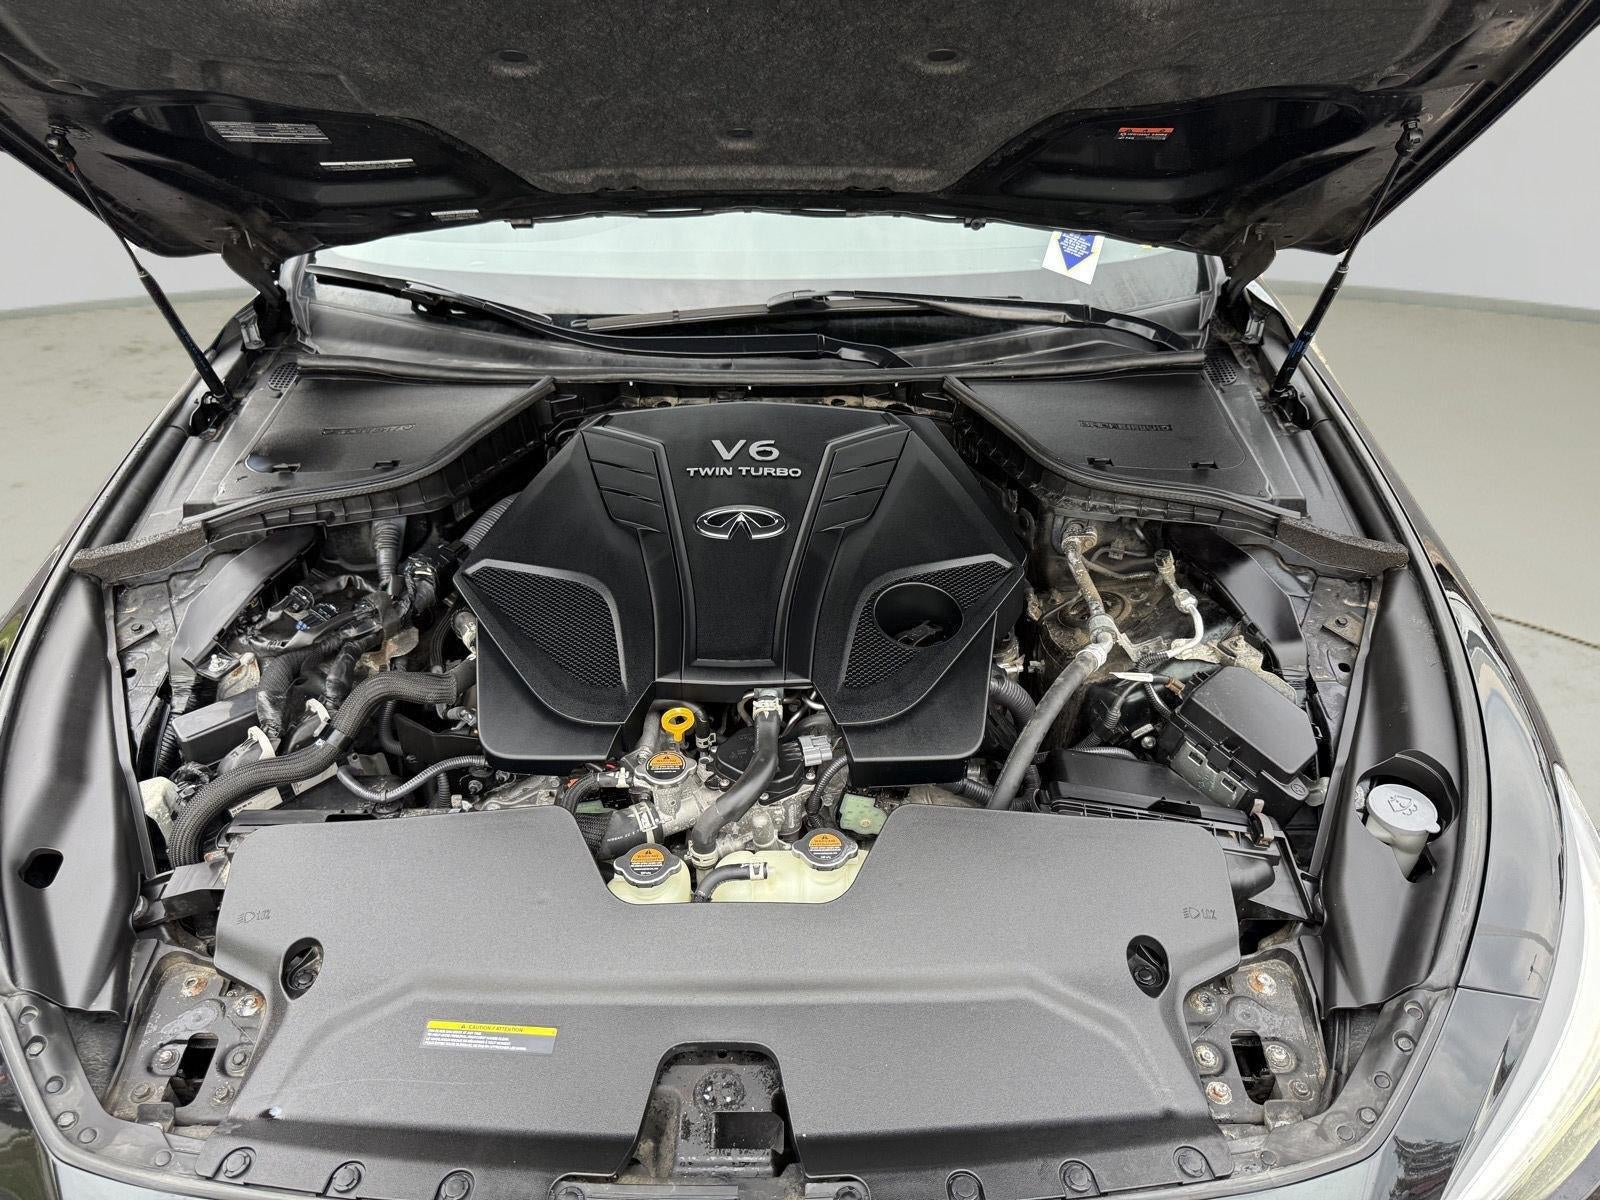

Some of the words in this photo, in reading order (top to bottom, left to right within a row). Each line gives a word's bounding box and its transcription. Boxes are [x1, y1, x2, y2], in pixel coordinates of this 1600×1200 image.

[711, 439, 780, 461] V6
[686, 466, 733, 477] TWIN
[738, 466, 802, 478] TURBO
[468, 1023, 491, 1031] CAUTION
